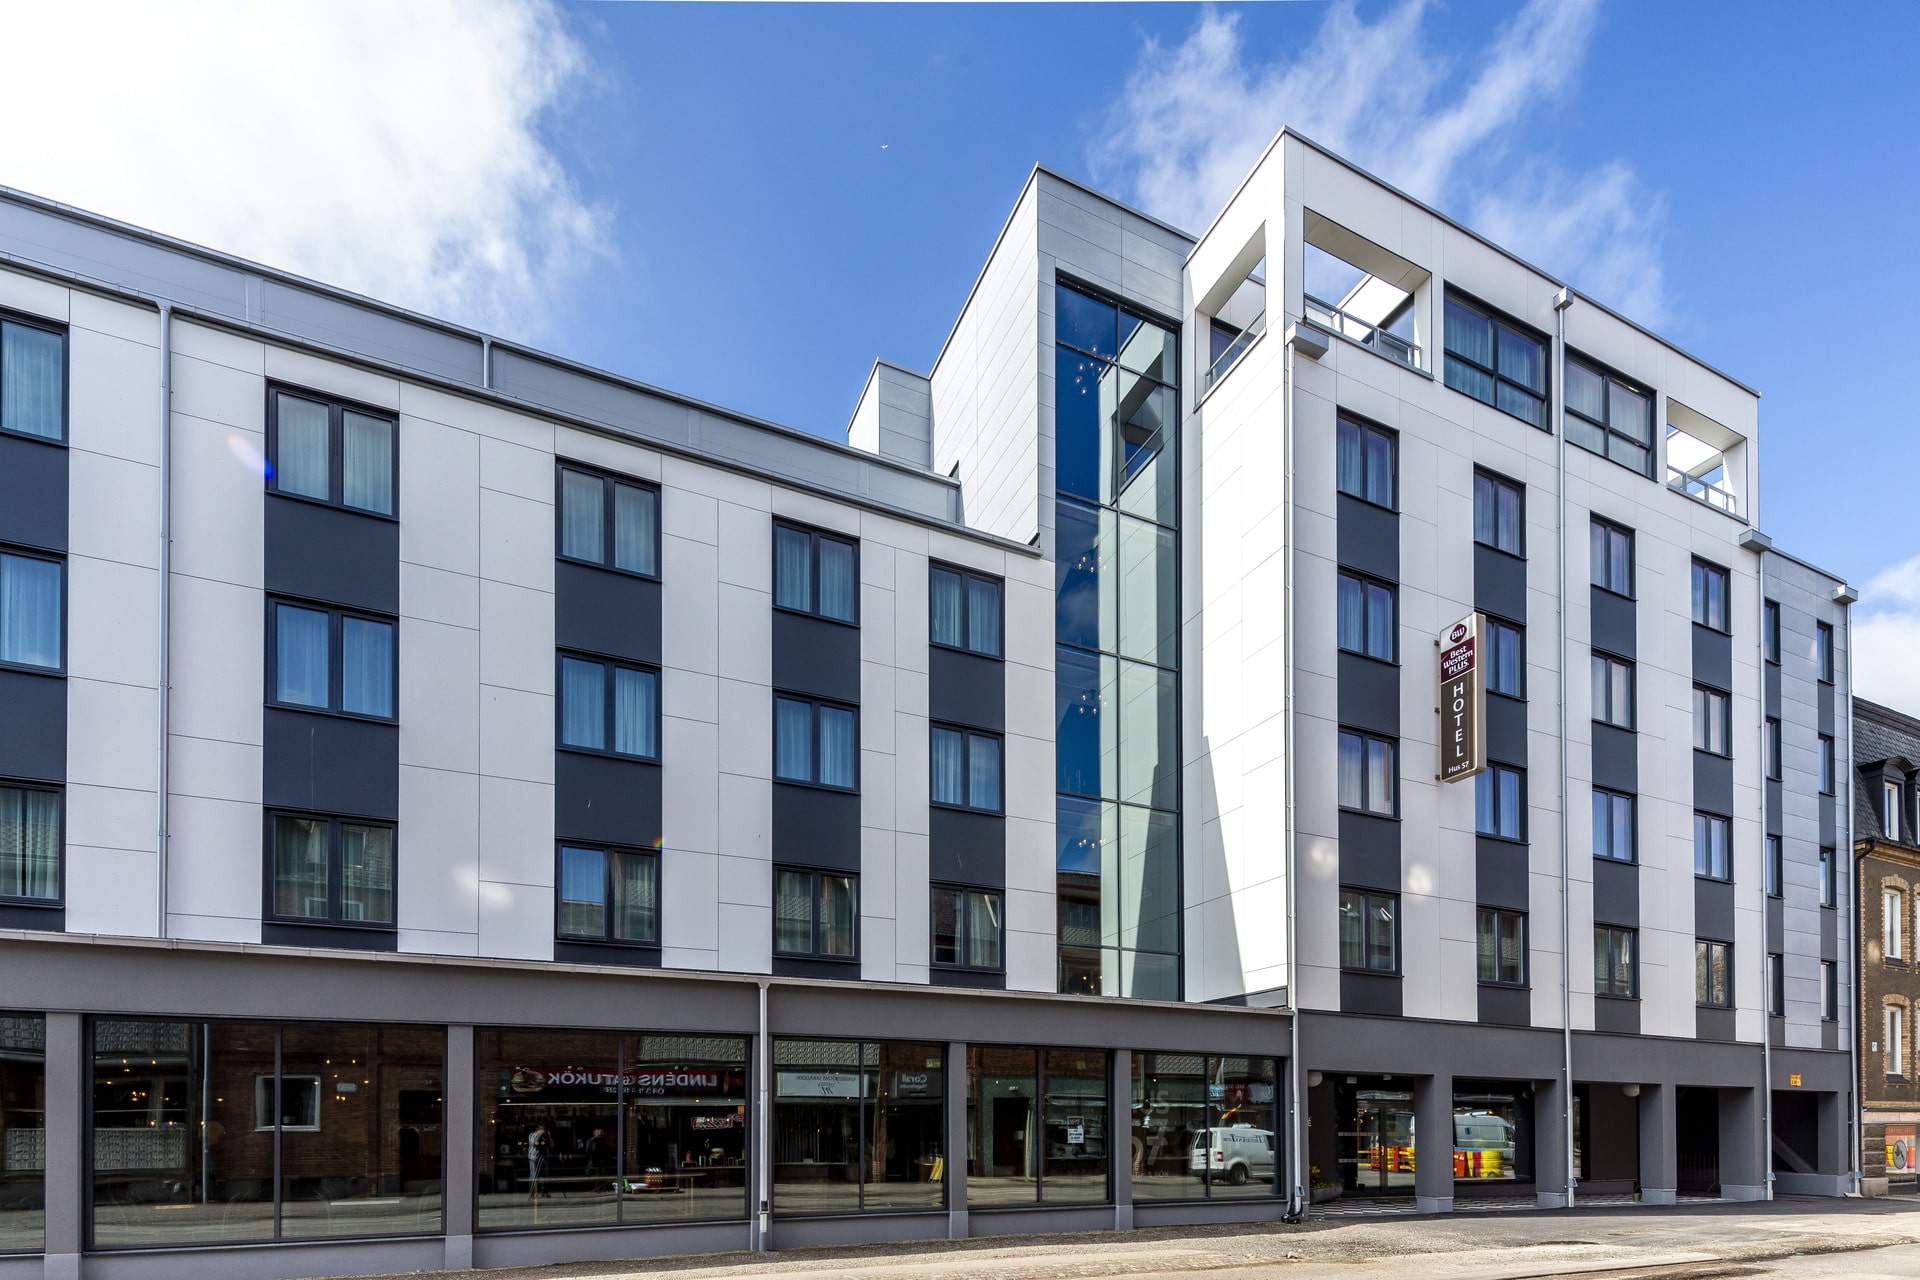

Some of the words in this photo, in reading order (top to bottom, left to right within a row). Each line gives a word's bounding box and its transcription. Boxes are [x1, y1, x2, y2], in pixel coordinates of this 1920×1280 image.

[1451, 625, 1465, 639] BW
[1443, 649, 1473, 669] Western
[1450, 645, 1467, 659] Best
[1449, 660, 1469, 675] PLUS
[1453, 682, 1464, 758] HOTEL
[1448, 764, 1461, 774] Hus
